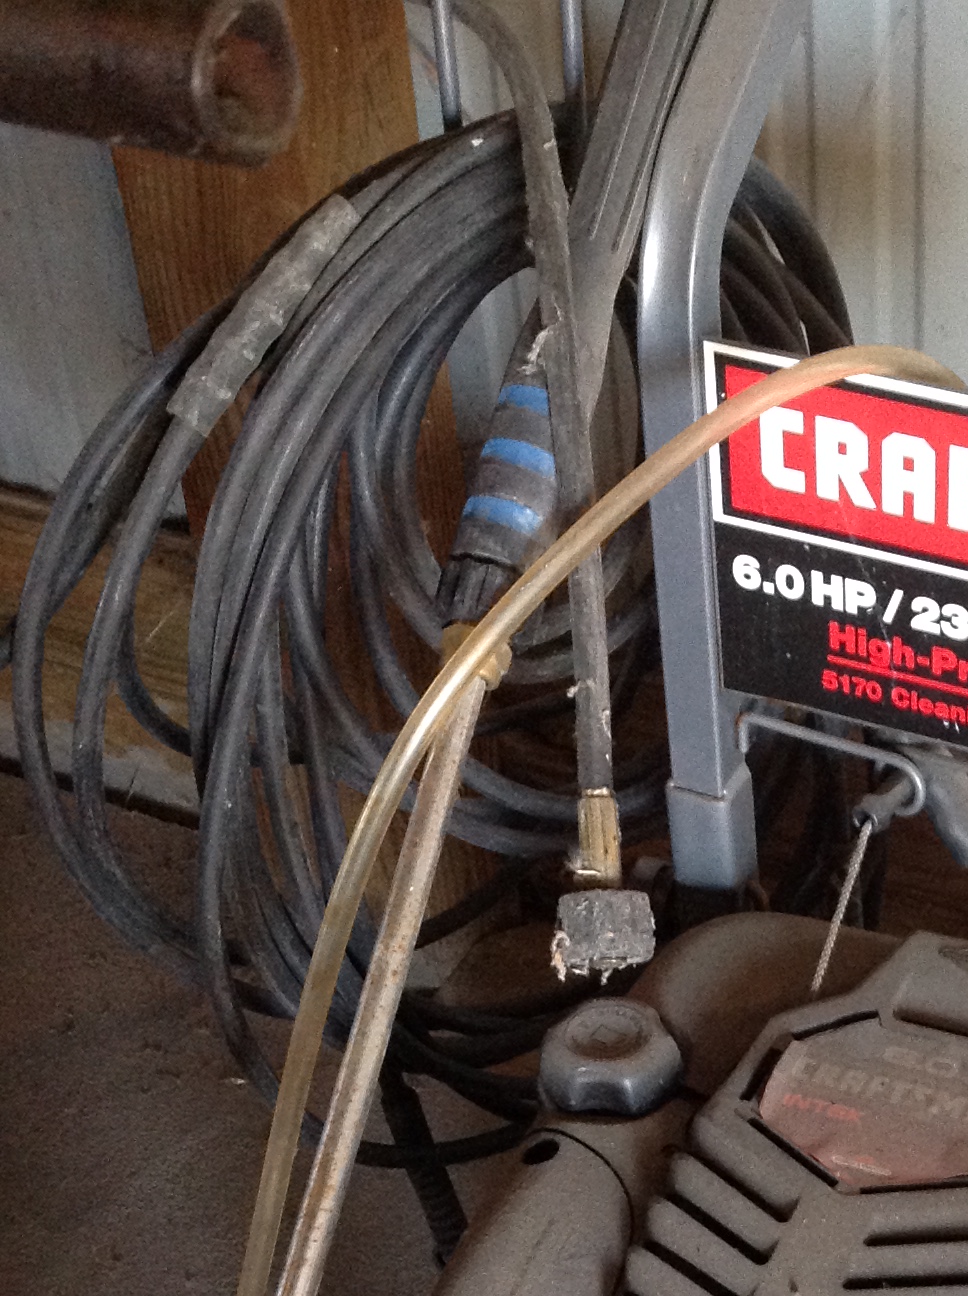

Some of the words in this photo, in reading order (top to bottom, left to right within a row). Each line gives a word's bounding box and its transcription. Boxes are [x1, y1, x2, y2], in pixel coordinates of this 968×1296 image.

[732, 554, 805, 600] 6.0
[810, 569, 877, 615] HP
[821, 669, 883, 702] 5170
